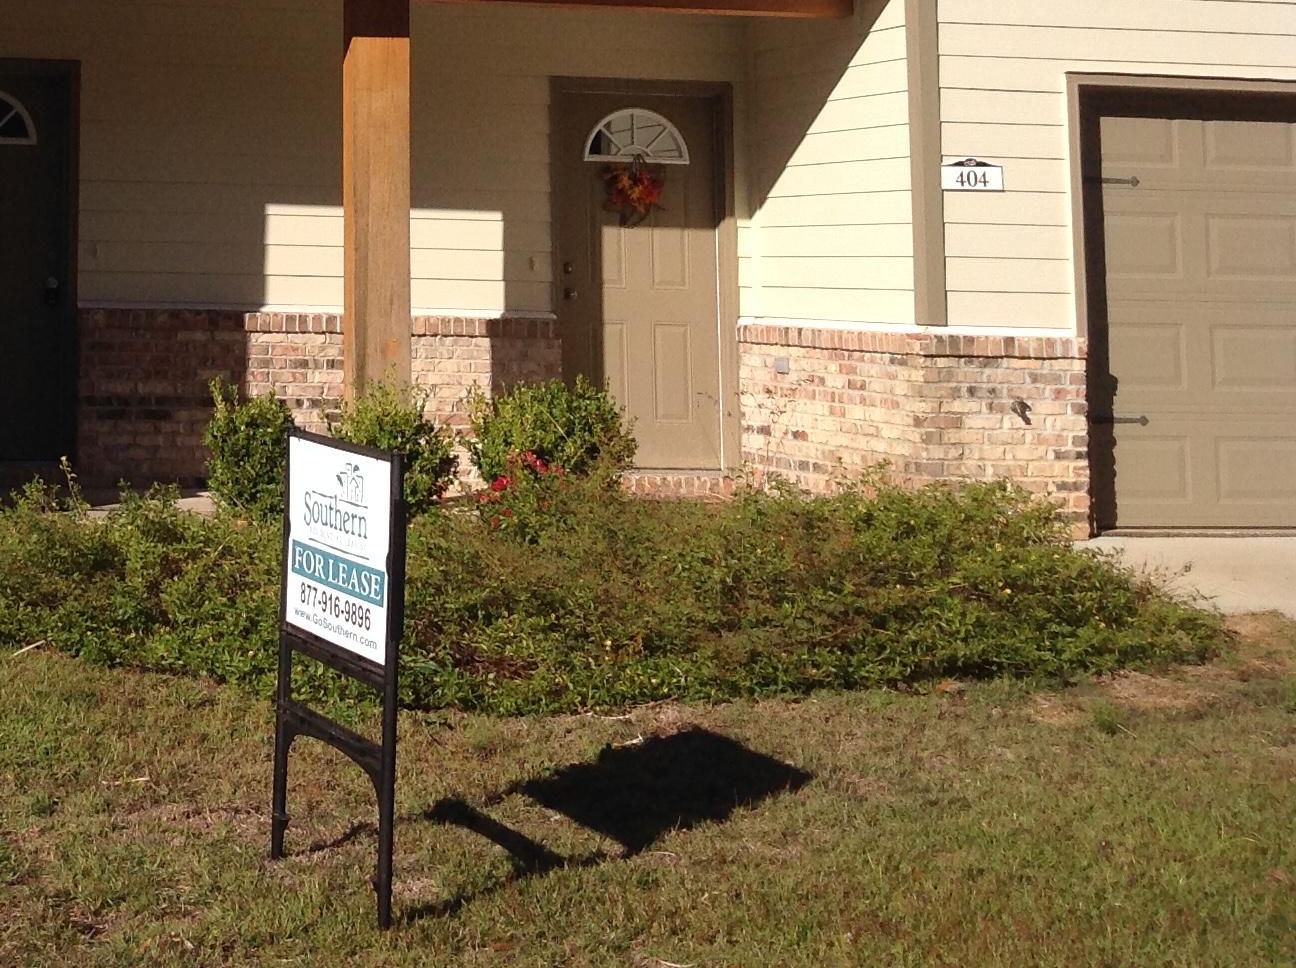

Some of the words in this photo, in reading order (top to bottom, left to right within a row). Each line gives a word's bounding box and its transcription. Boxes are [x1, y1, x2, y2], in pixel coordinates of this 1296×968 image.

[956, 170, 989, 187] 404
[304, 491, 368, 539] Southern
[294, 546, 325, 580] FOR
[329, 559, 381, 600] LEASE
[293, 607, 378, 650] www.GoSouthern.com
[300, 582, 371, 631] 877-916-9896
